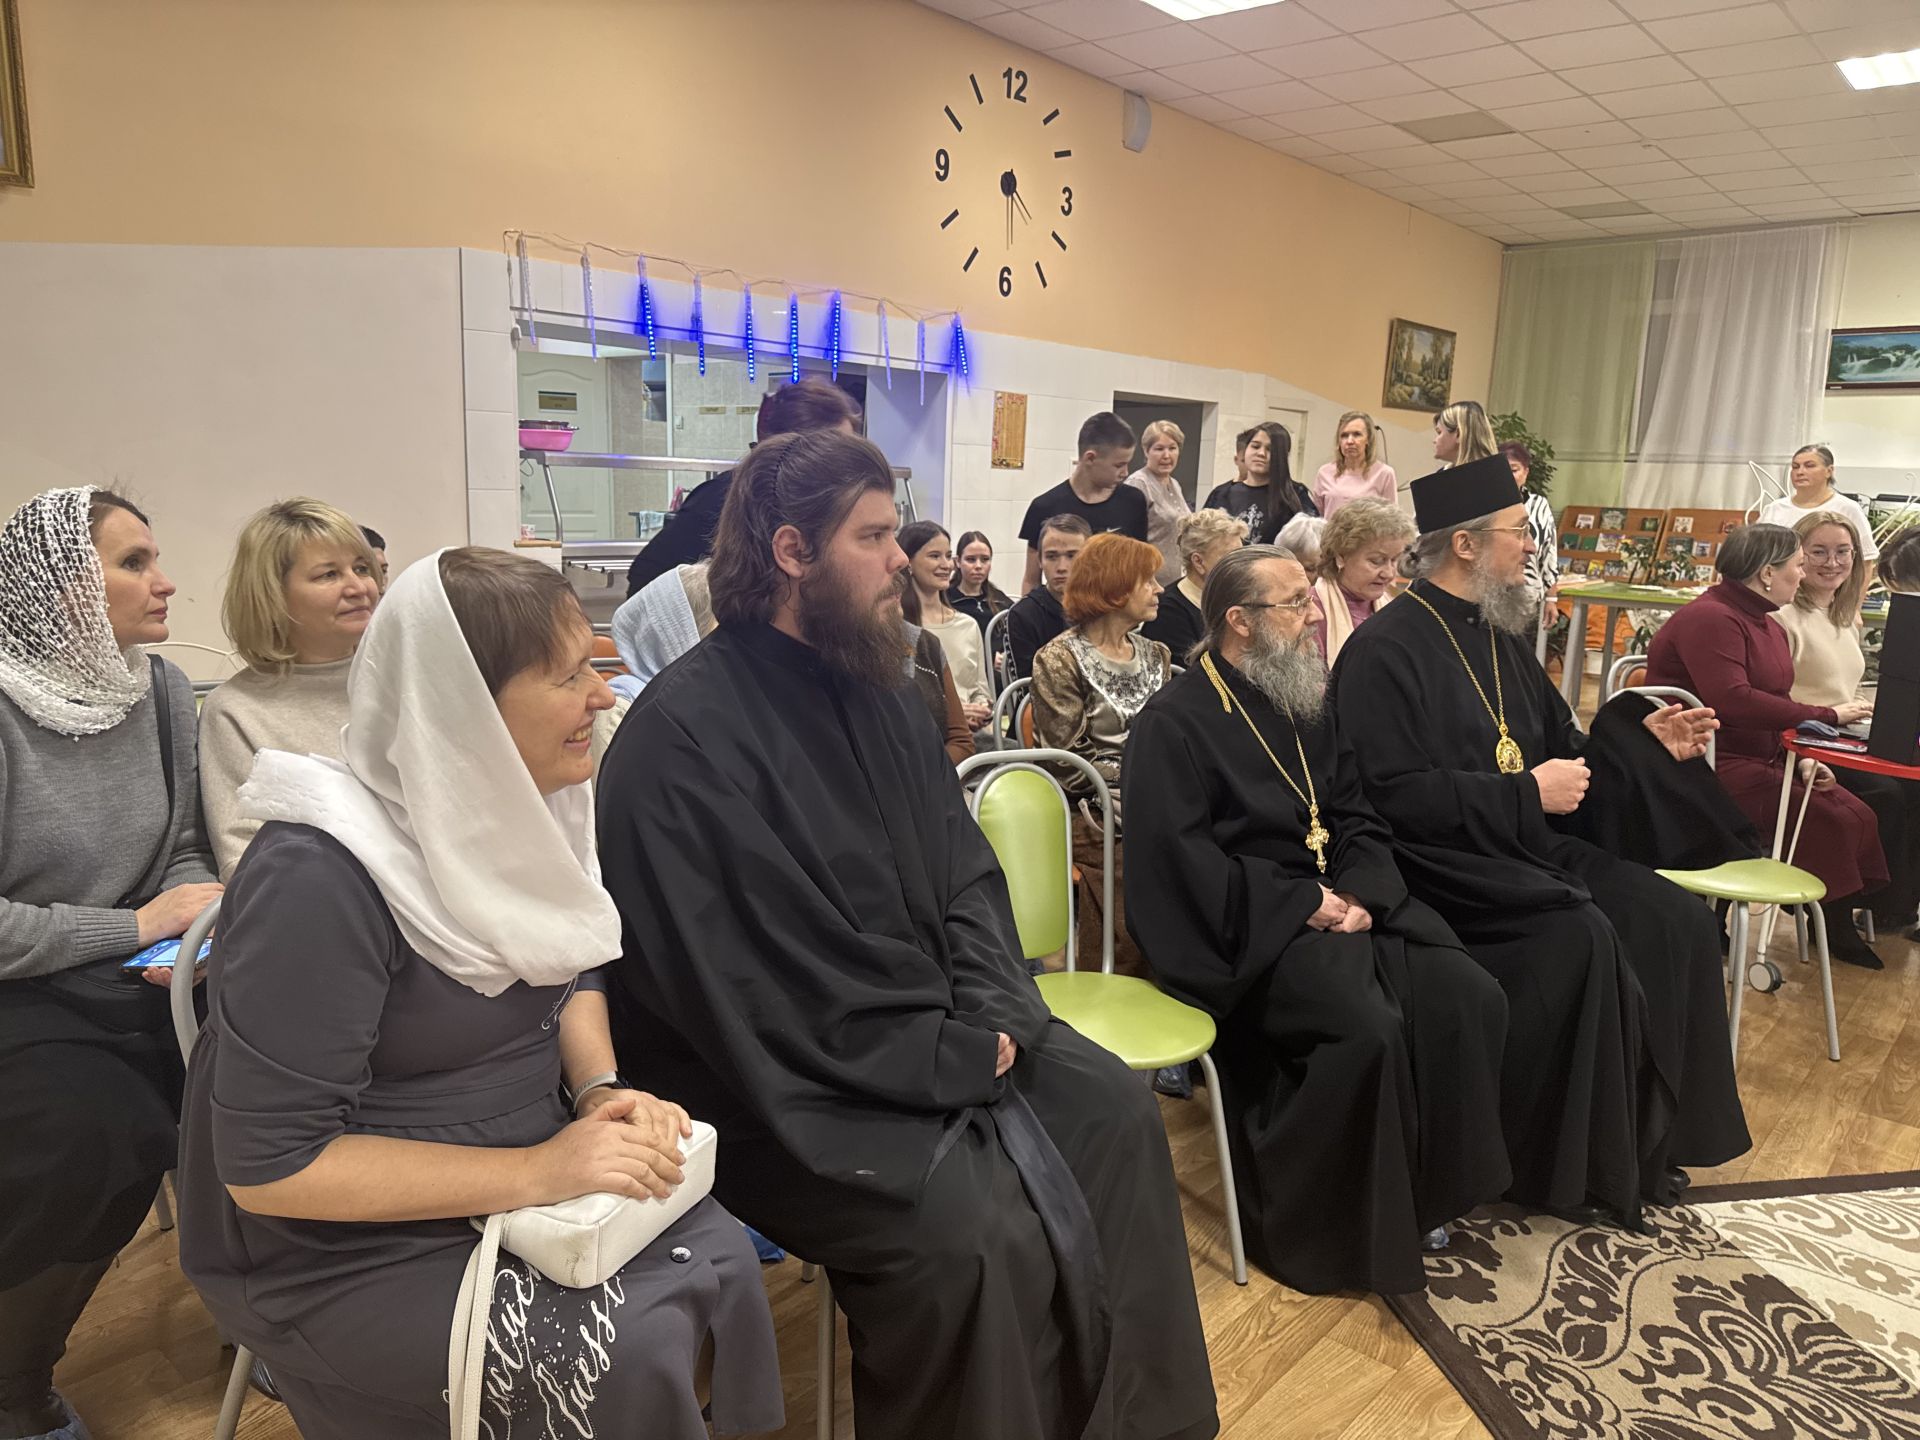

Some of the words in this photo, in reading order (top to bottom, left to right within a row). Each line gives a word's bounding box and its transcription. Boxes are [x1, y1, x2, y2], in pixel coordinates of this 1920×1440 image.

[1002, 66, 1028, 103] 12
[935, 148, 950, 182] 9
[1060, 186, 1073, 216] 3
[998, 266, 1012, 297] 6
